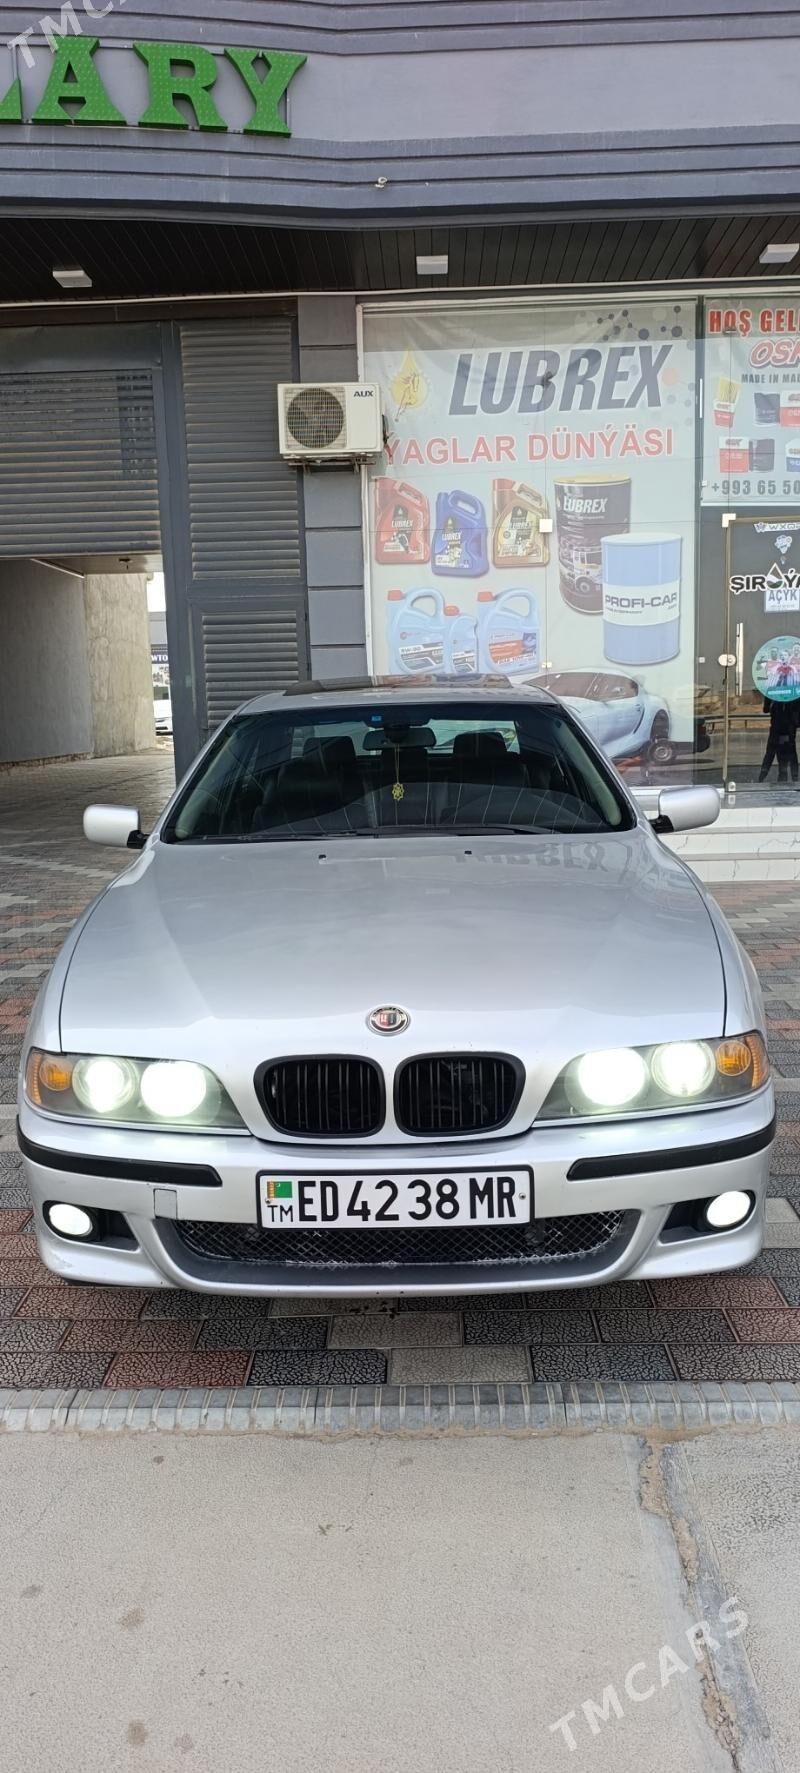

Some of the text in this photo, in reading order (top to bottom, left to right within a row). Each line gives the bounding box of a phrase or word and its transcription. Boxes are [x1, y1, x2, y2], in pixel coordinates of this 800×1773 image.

[709, 309, 800, 336] HOŞ GEL
[449, 345, 673, 415] LUBREX
[741, 373, 765, 384] MADE
[768, 373, 779, 384] IN
[353, 390, 374, 398] AUX
[383, 423, 673, 465] YAGLAR DÜNÝÄSI
[711, 480, 751, 496] +993
[757, 480, 776, 495] 65
[563, 495, 608, 513] LUBREX
[605, 592, 677, 608] PROFI-CAR
[768, 589, 797, 604] AÇYK
[298, 1176, 516, 1222] ED 42 38 MR
[267, 1205, 293, 1222] TM
